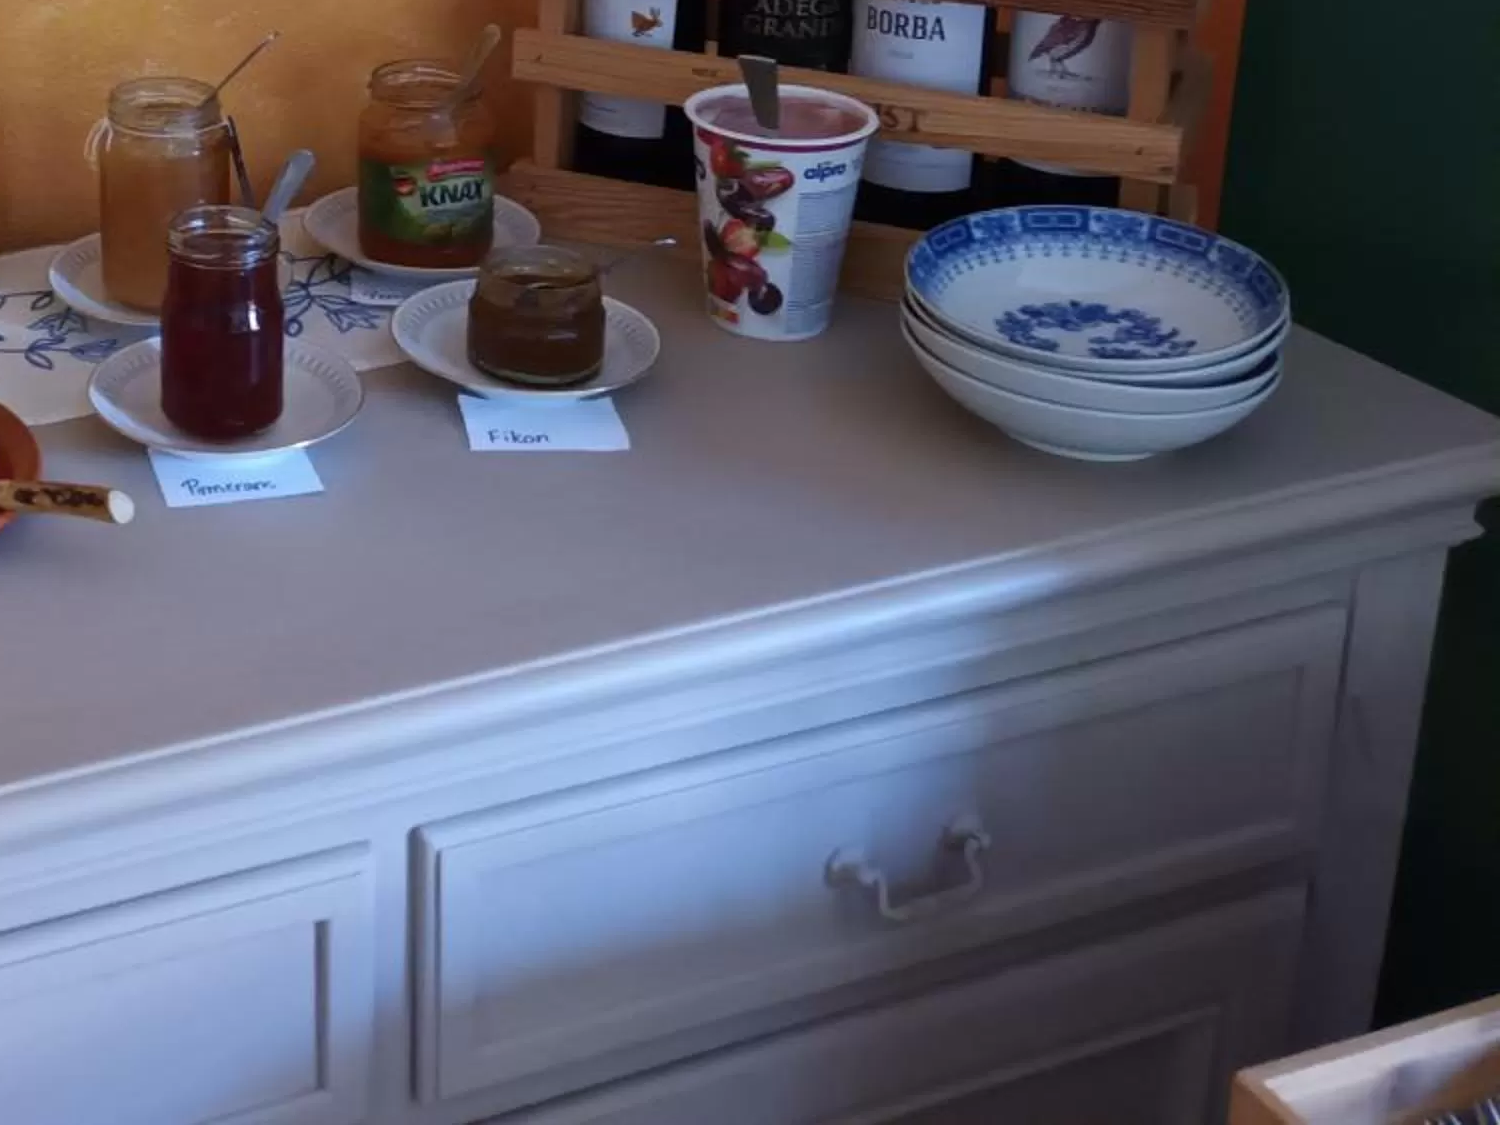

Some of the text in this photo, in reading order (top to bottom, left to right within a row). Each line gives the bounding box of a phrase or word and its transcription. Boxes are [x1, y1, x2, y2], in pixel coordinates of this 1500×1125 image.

[867, 5, 946, 42] BORBA
[803, 163, 847, 183] alpro
[488, 427, 549, 444] Fikon
